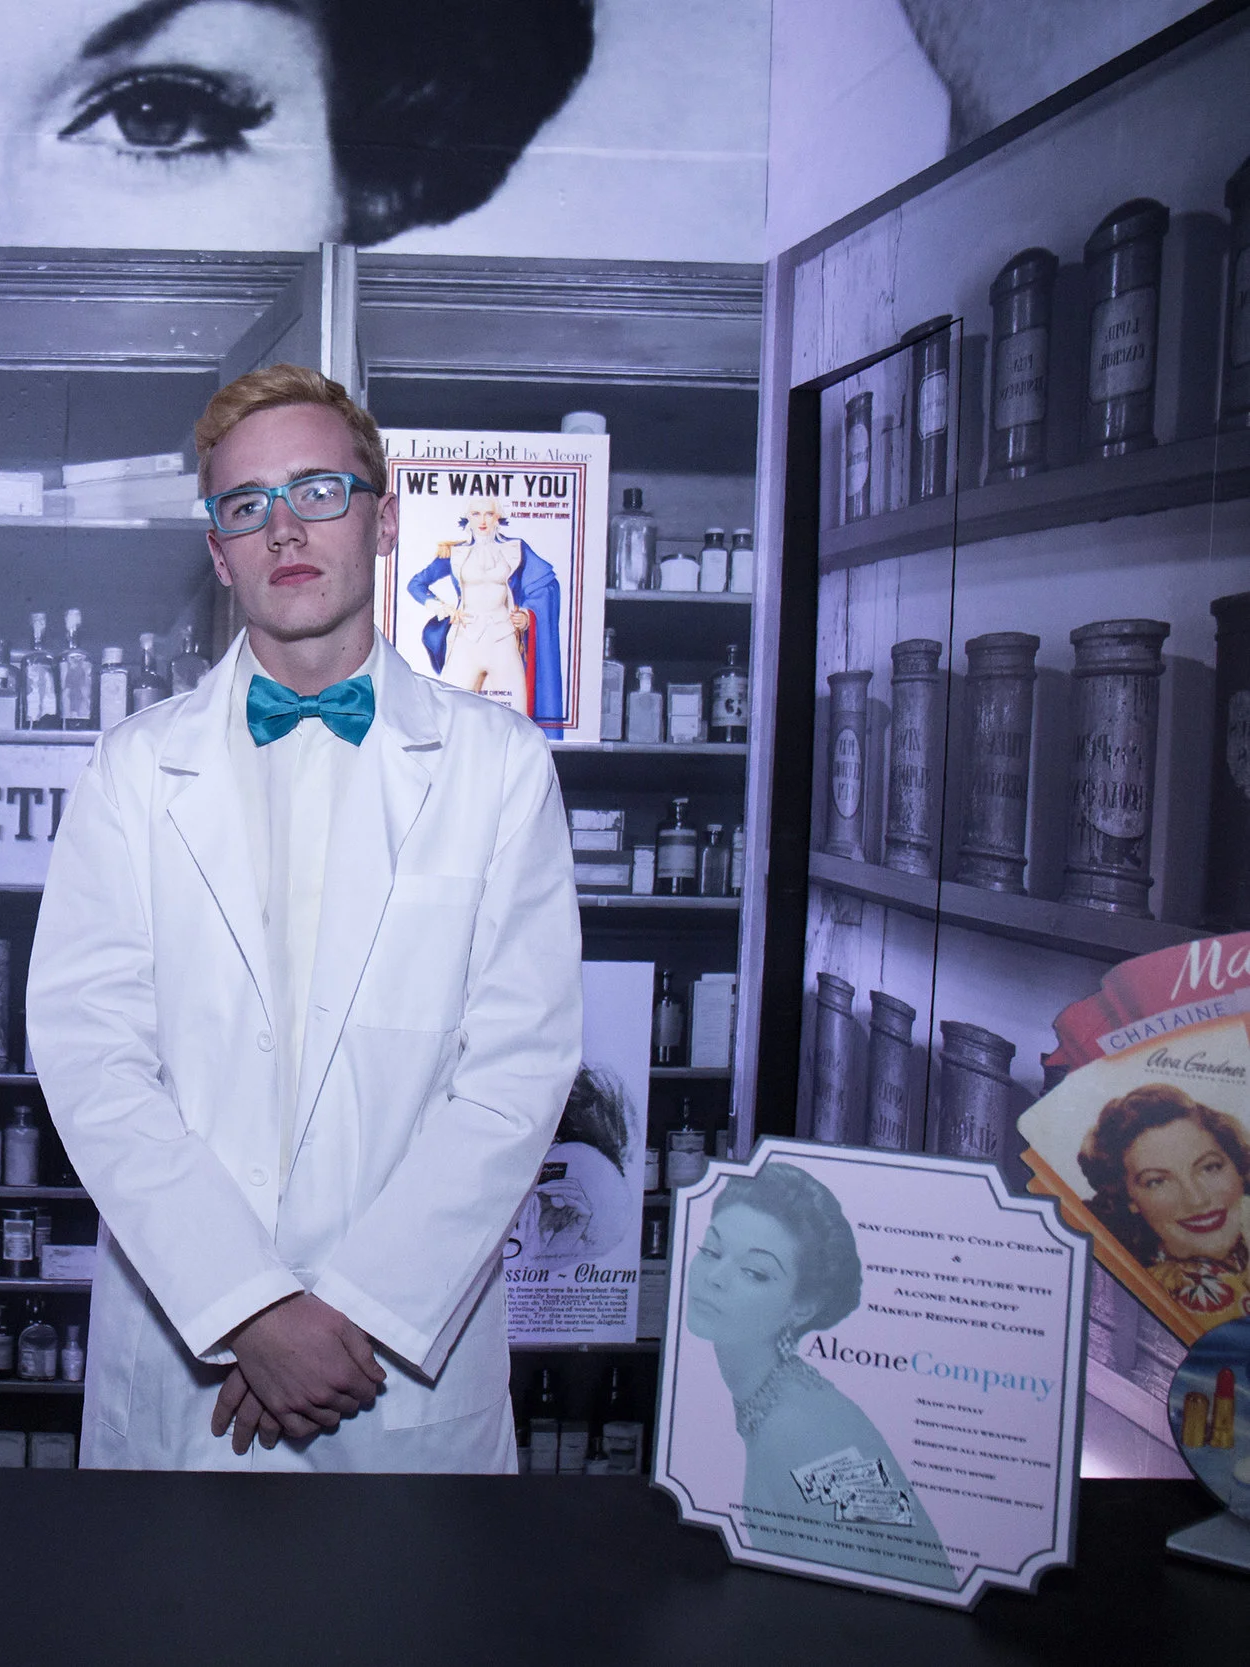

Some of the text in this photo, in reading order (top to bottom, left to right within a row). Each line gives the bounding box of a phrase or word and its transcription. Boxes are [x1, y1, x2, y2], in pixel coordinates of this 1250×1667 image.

[411, 439, 593, 467] LimeLight by Alcone
[406, 472, 568, 498] WE WANT YOU
[1171, 940, 1250, 1001] Ma
[883, 1226, 945, 1240] GOODBYE
[948, 1234, 965, 1243] TO
[968, 1236, 1004, 1248] COLD
[505, 1266, 549, 1283] ssion
[574, 1262, 637, 1284] Charm
[933, 1272, 959, 1283] THE
